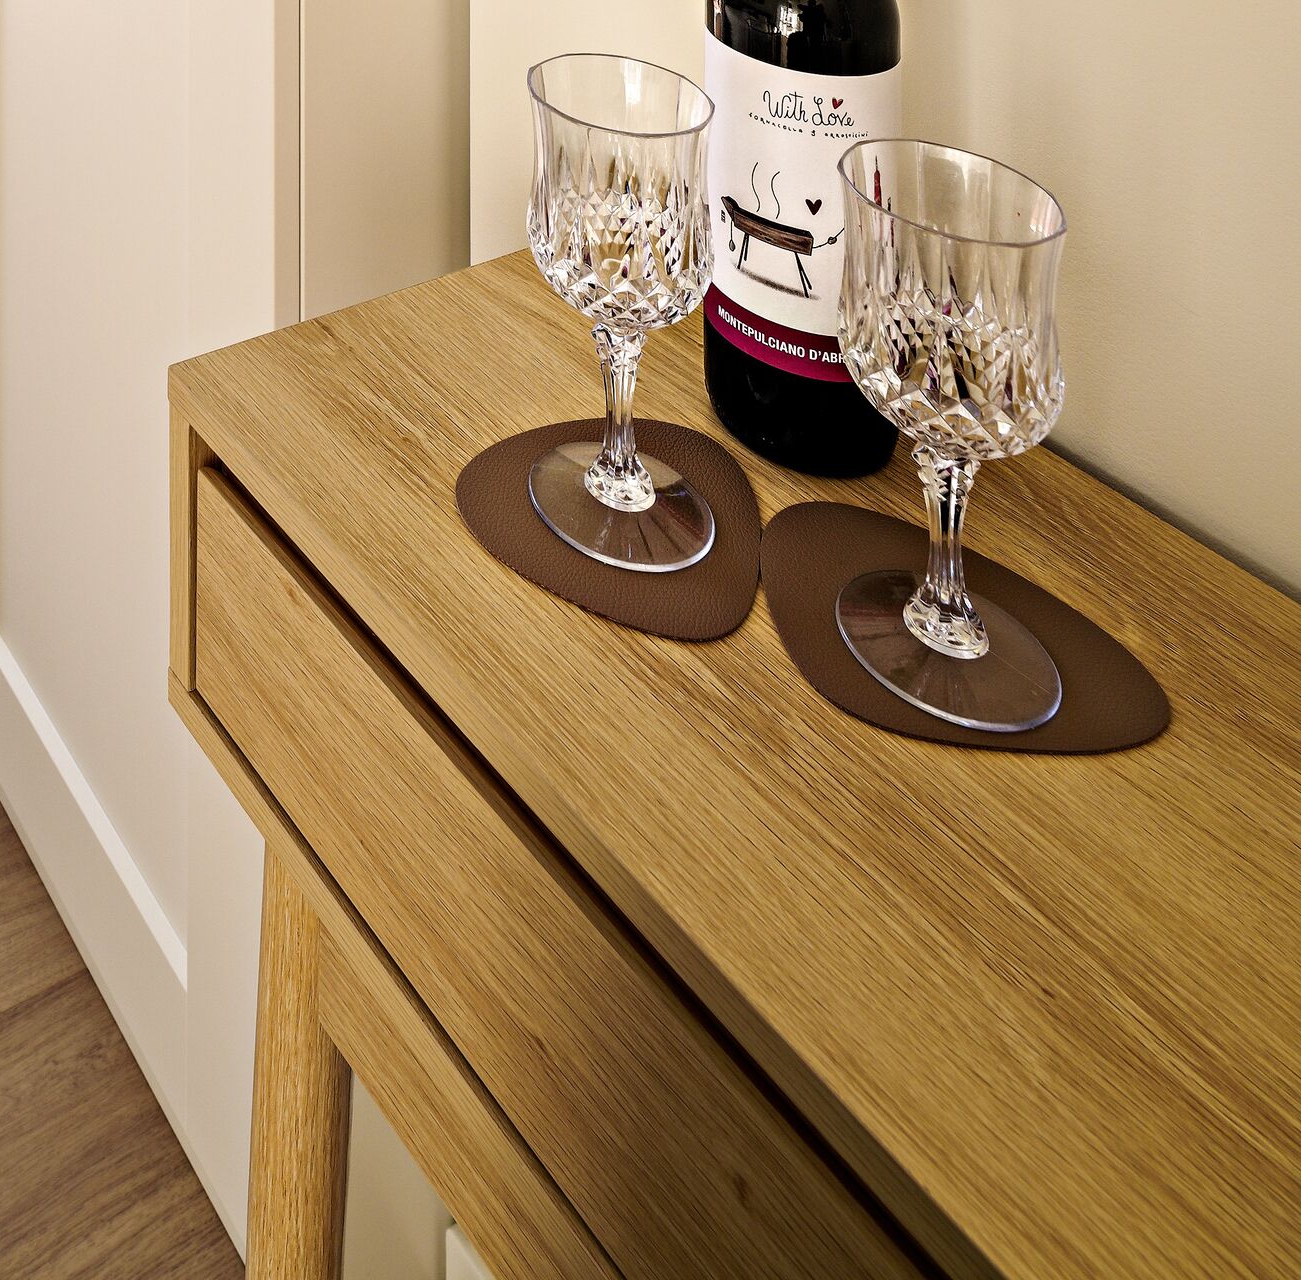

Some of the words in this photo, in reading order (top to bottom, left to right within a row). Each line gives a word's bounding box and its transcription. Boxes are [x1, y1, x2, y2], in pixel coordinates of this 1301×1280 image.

[763, 90, 808, 123] With
[812, 96, 855, 127] Love
[718, 305, 805, 358] MONTEPULCIANO
[809, 348, 846, 364] D'ABR
